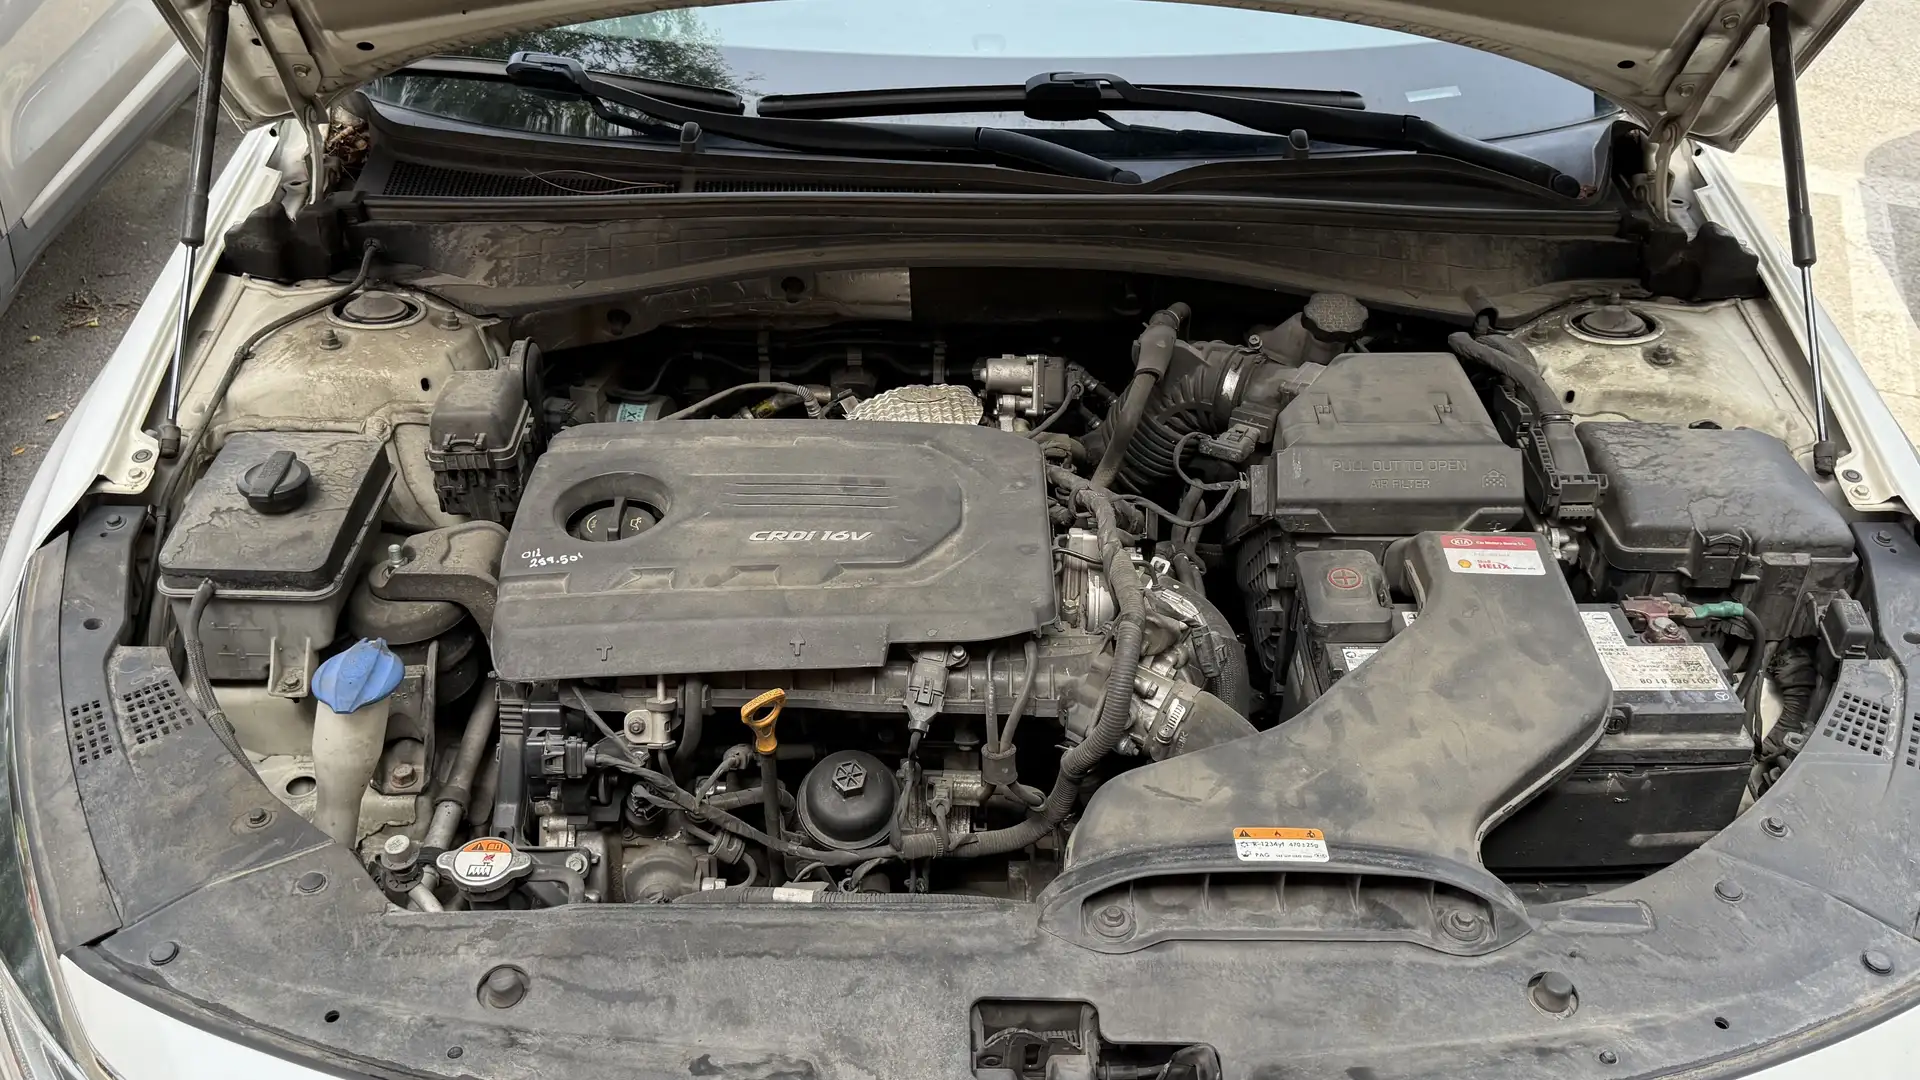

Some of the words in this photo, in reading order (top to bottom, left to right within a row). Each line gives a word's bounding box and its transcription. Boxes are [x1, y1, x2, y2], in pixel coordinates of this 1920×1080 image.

[1332, 460, 1368, 472] PULL
[1372, 460, 1400, 472] OUT
[1403, 460, 1424, 472] TO
[1428, 460, 1467, 472] OPEN
[1370, 479, 1389, 488] AIR
[1392, 479, 1430, 489] FILTER
[820, 530, 872, 541] 16V
[1452, 538, 1471, 546] KIA
